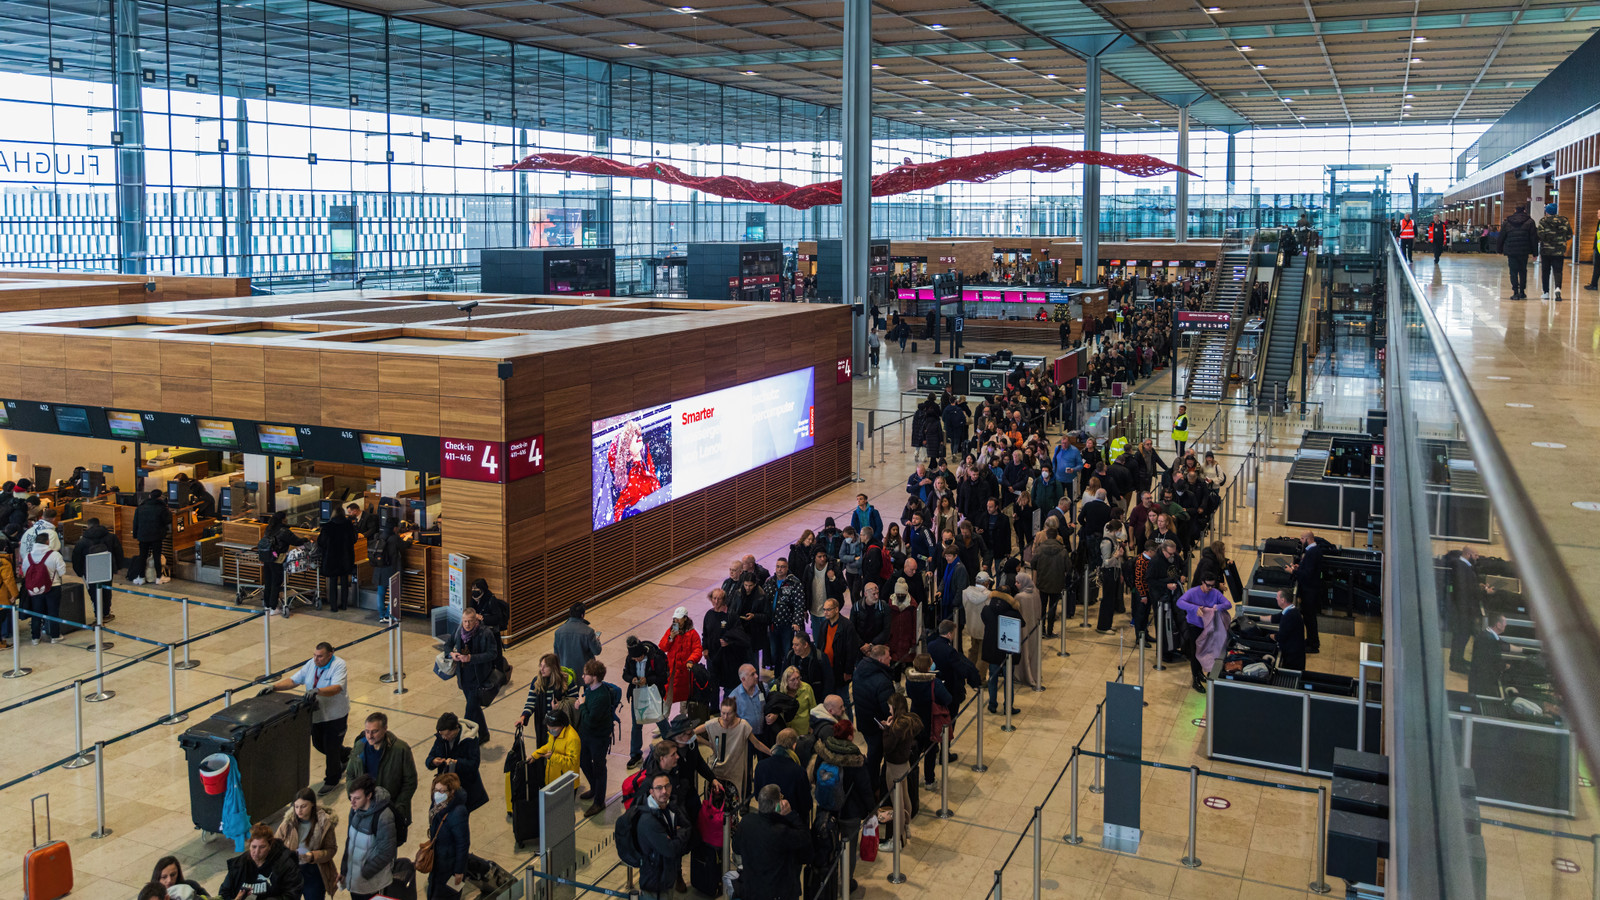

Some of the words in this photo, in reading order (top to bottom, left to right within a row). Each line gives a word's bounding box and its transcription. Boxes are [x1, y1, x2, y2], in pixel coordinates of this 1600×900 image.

[845, 359, 851, 377] 4
[180, 416, 191, 424] 414
[682, 407, 715, 425] Smarter
[300, 427, 311, 435] 415
[341, 431, 353, 439] 416
[445, 441, 474, 451] Check-in
[511, 442, 528, 451] Check-in
[528, 439, 542, 466] 4
[481, 445, 498, 474] 4
